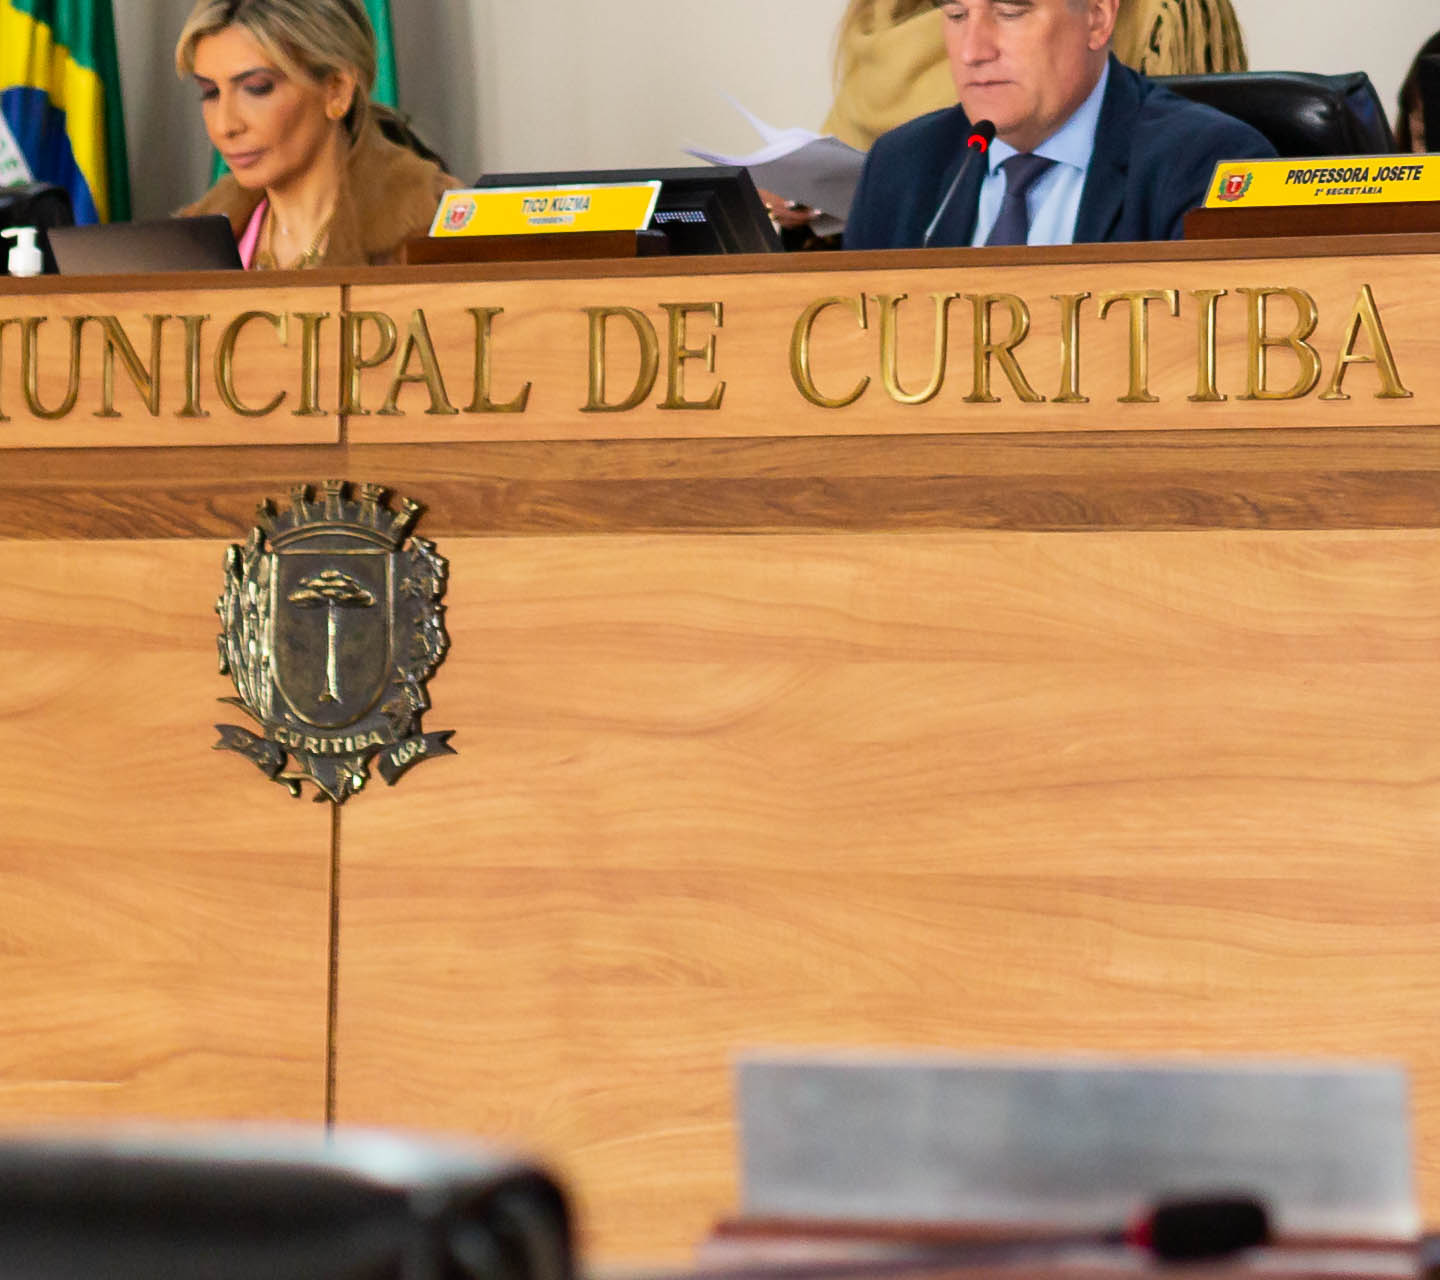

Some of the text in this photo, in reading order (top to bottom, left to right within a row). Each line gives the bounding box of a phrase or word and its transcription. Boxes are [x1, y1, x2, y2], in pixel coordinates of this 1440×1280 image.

[1285, 165, 1424, 184] PROFESSORA JOSETE
[580, 301, 726, 415] DE
[790, 283, 1414, 409] CURITIBA
[274, 726, 385, 754] CURITIBA
